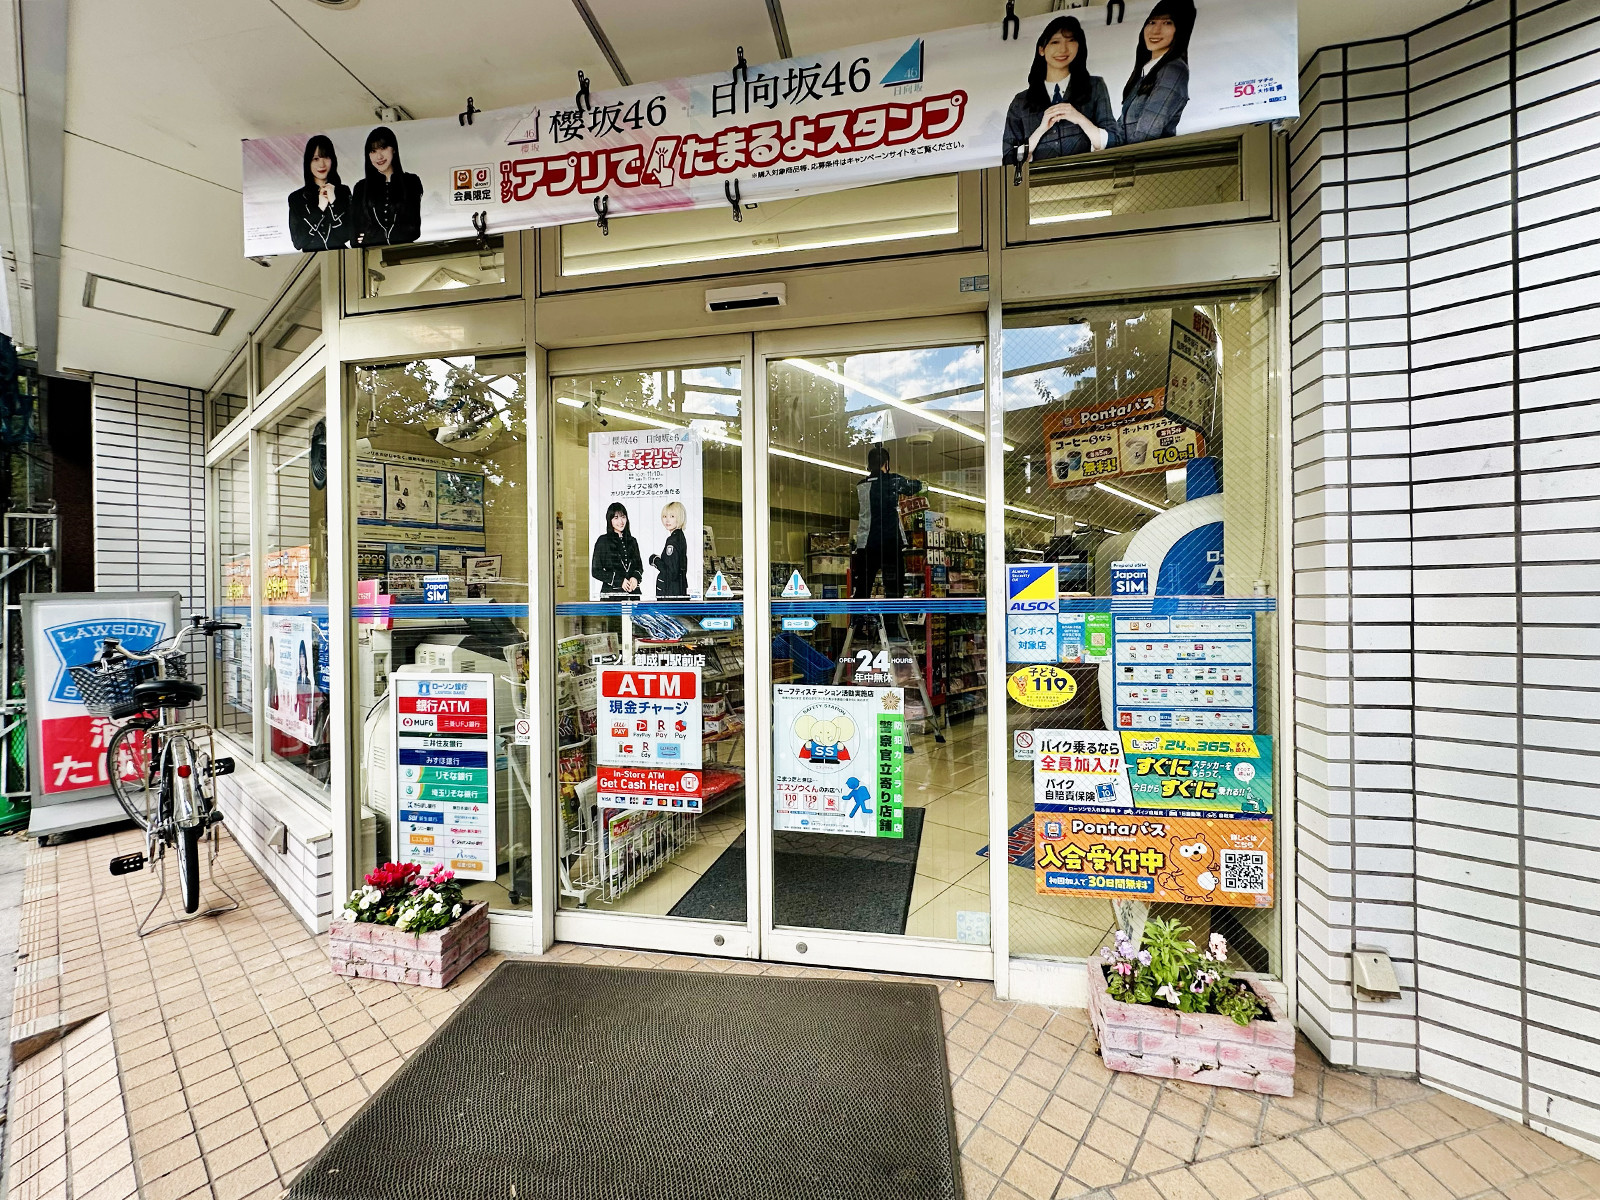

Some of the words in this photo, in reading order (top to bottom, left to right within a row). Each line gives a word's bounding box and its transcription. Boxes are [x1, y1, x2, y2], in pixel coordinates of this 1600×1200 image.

[712, 57, 871, 118] 日向坂46
[549, 95, 667, 144] 櫻坂46
[501, 161, 512, 202] ローソン
[513, 146, 643, 202] アプリで
[681, 91, 967, 178] たまるよスタンプ
[454, 189, 492, 202] 会員限定
[1080, 396, 1155, 424] Pontaパス
[1114, 571, 1147, 580] Japan
[1116, 580, 1145, 592] SIM
[427, 590, 446, 601] SIM
[1010, 602, 1056, 612] ALSOK
[58, 624, 156, 643] LAWSON
[1010, 626, 1055, 636] インボイス
[1018, 640, 1046, 650] 対象店
[634, 653, 706, 666] 御成門駅前店
[856, 650, 890, 672] 24
[855, 673, 892, 682] 年中無休
[1028, 667, 1058, 677] 子ども
[618, 674, 680, 696] ATM
[416, 699, 470, 712] 銀行ATM
[610, 700, 688, 715] 現金チャージ
[802, 704, 822, 714] SAFETY
[824, 704, 846, 715] STATION
[1041, 739, 1120, 754] バイク乗るなら
[1041, 755, 1119, 773] 全員加入!!
[1136, 757, 1192, 776] すぐに
[1192, 760, 1232, 770] ステッカーを
[436, 771, 472, 781] りそな銀行
[613, 770, 645, 778] In-Store
[879, 720, 892, 832] 警察官立寄り店舗
[600, 778, 620, 788] Get
[620, 779, 646, 789] Cash
[650, 780, 679, 791] Here!
[1046, 779, 1074, 789] バイク
[1132, 783, 1160, 793] 今日から
[1161, 779, 1218, 799] すぐに
[432, 788, 478, 798] 埼玉りそな銀行
[1045, 790, 1095, 802] 自賠責保険
[1072, 819, 1167, 838] Pontaパス
[1230, 834, 1258, 842] 詳しくは
[1038, 842, 1166, 874] 入会受付中
